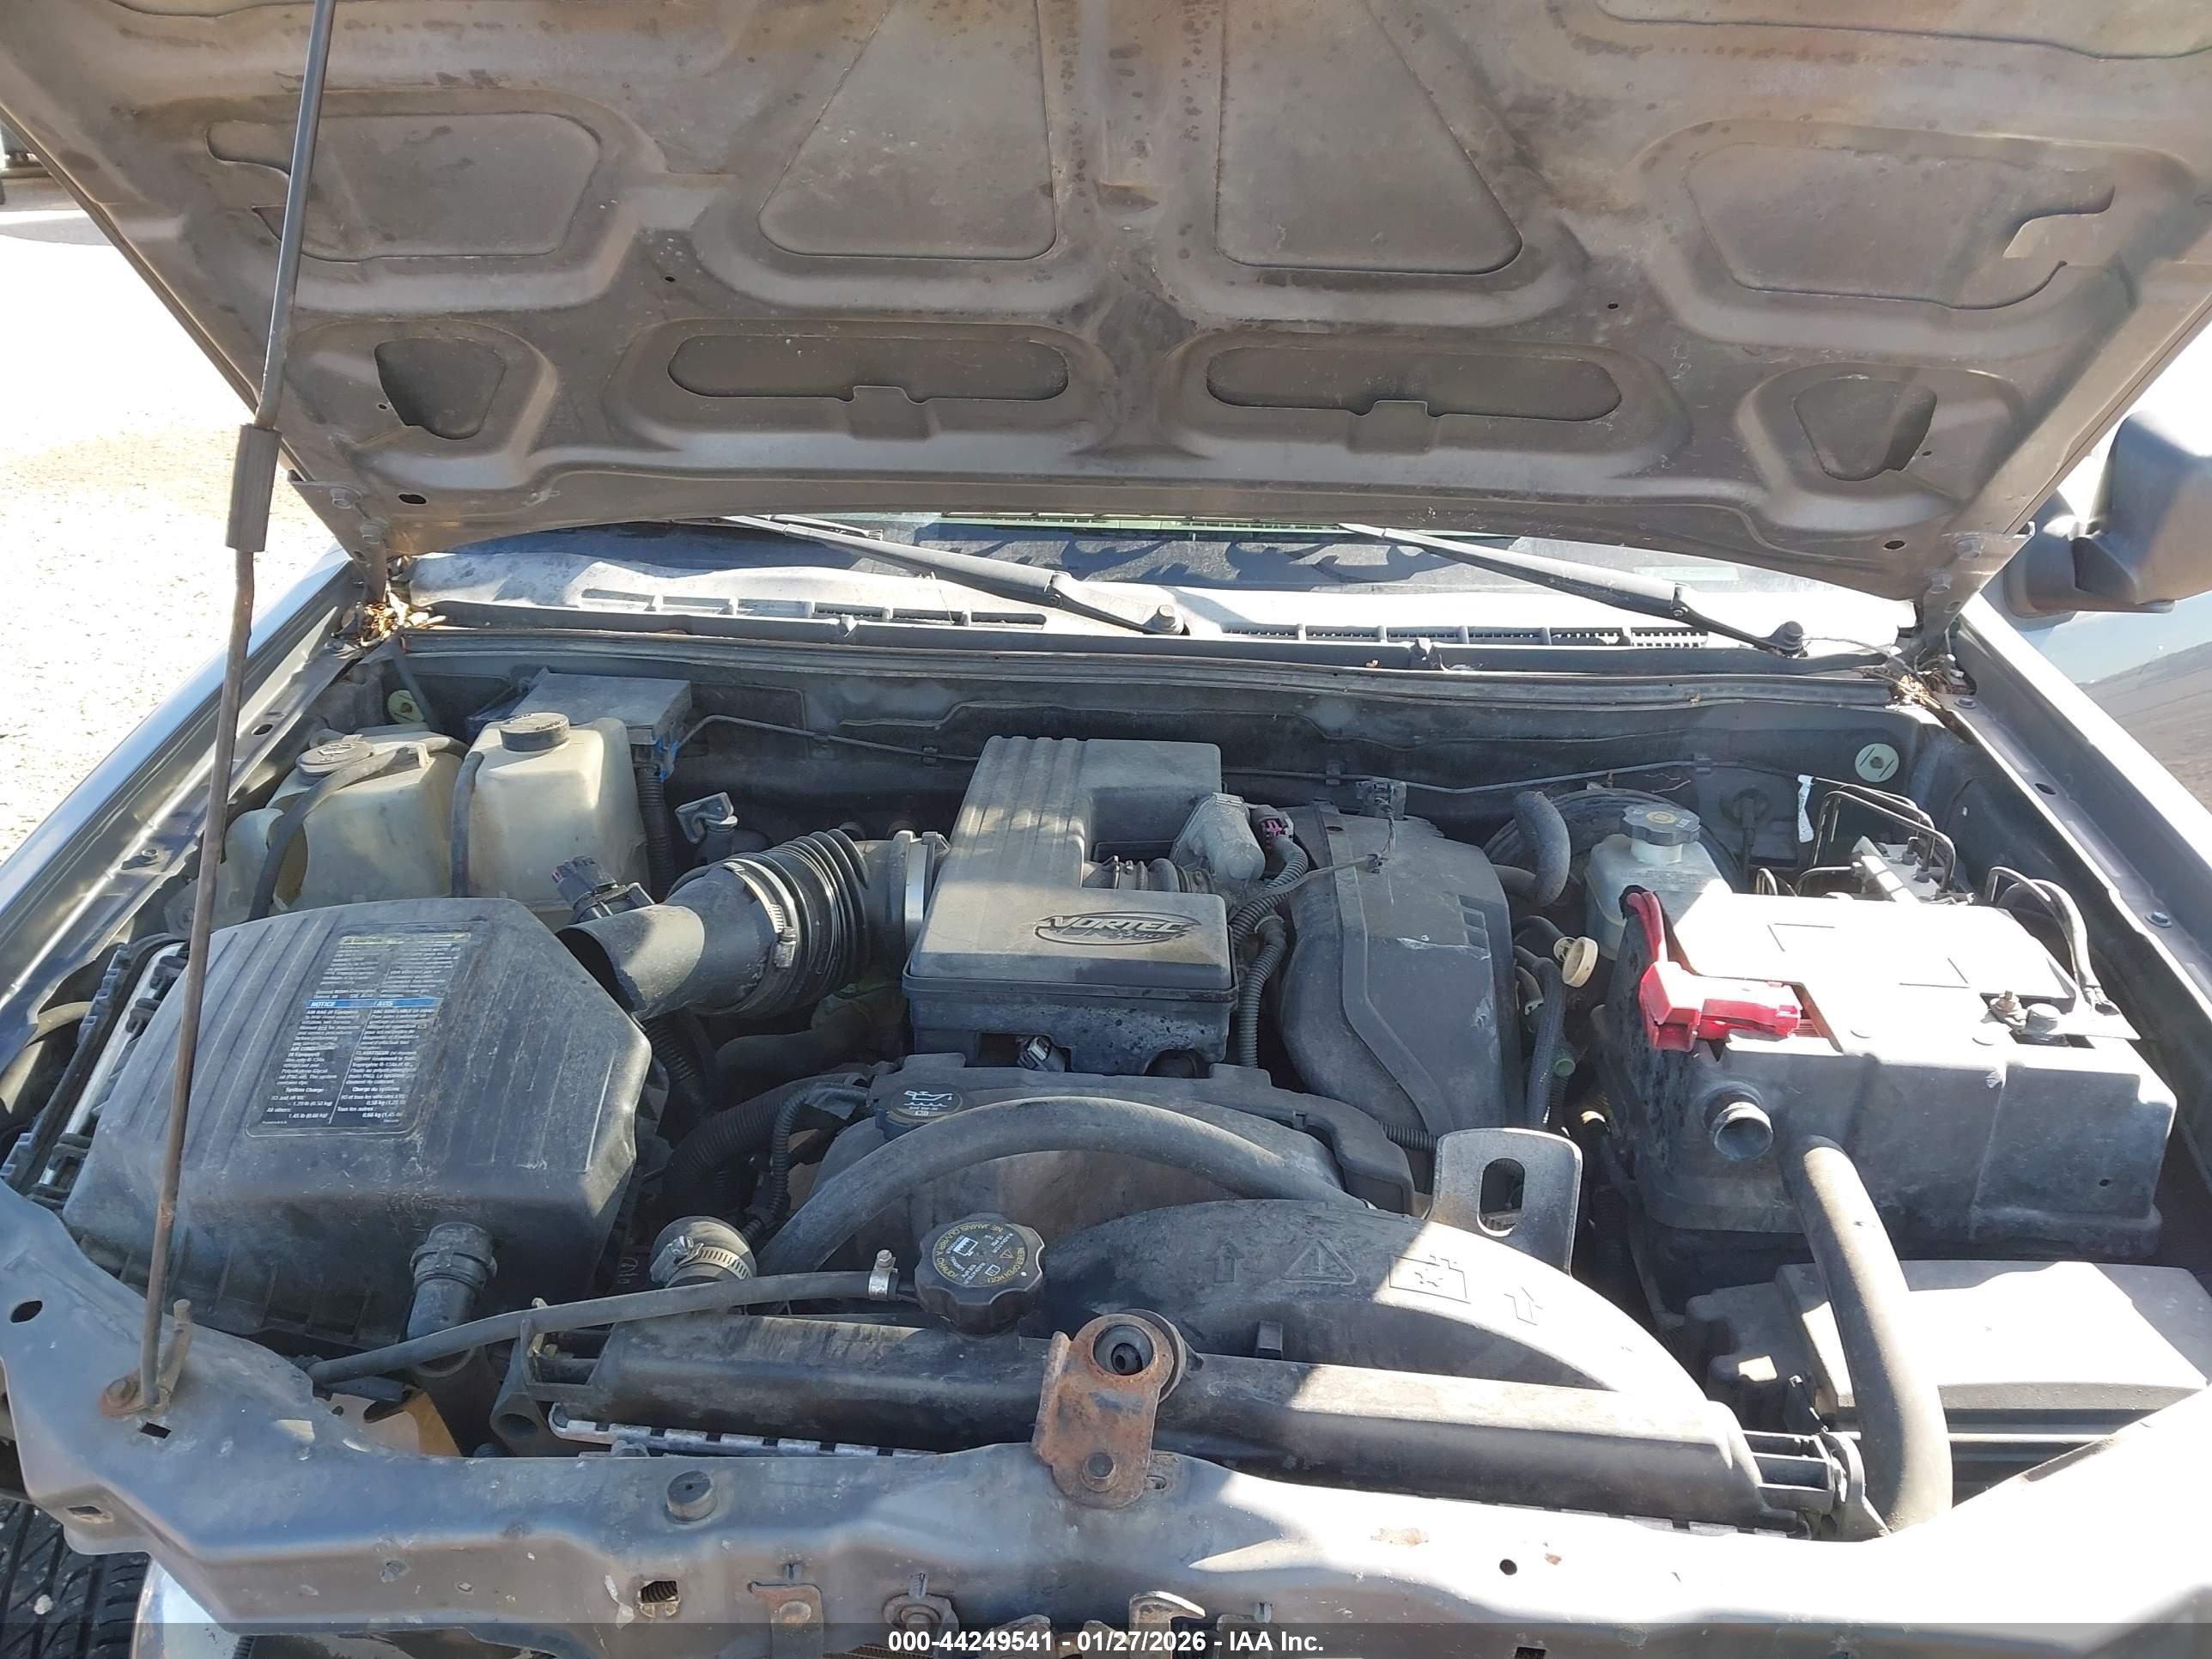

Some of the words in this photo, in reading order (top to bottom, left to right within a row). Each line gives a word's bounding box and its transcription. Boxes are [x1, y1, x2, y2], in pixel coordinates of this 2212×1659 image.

[1041, 916, 1188, 933] VORTEC
[961, 1223, 990, 1231] JAMAIS
[936, 1257, 958, 1279] CHAUD!
